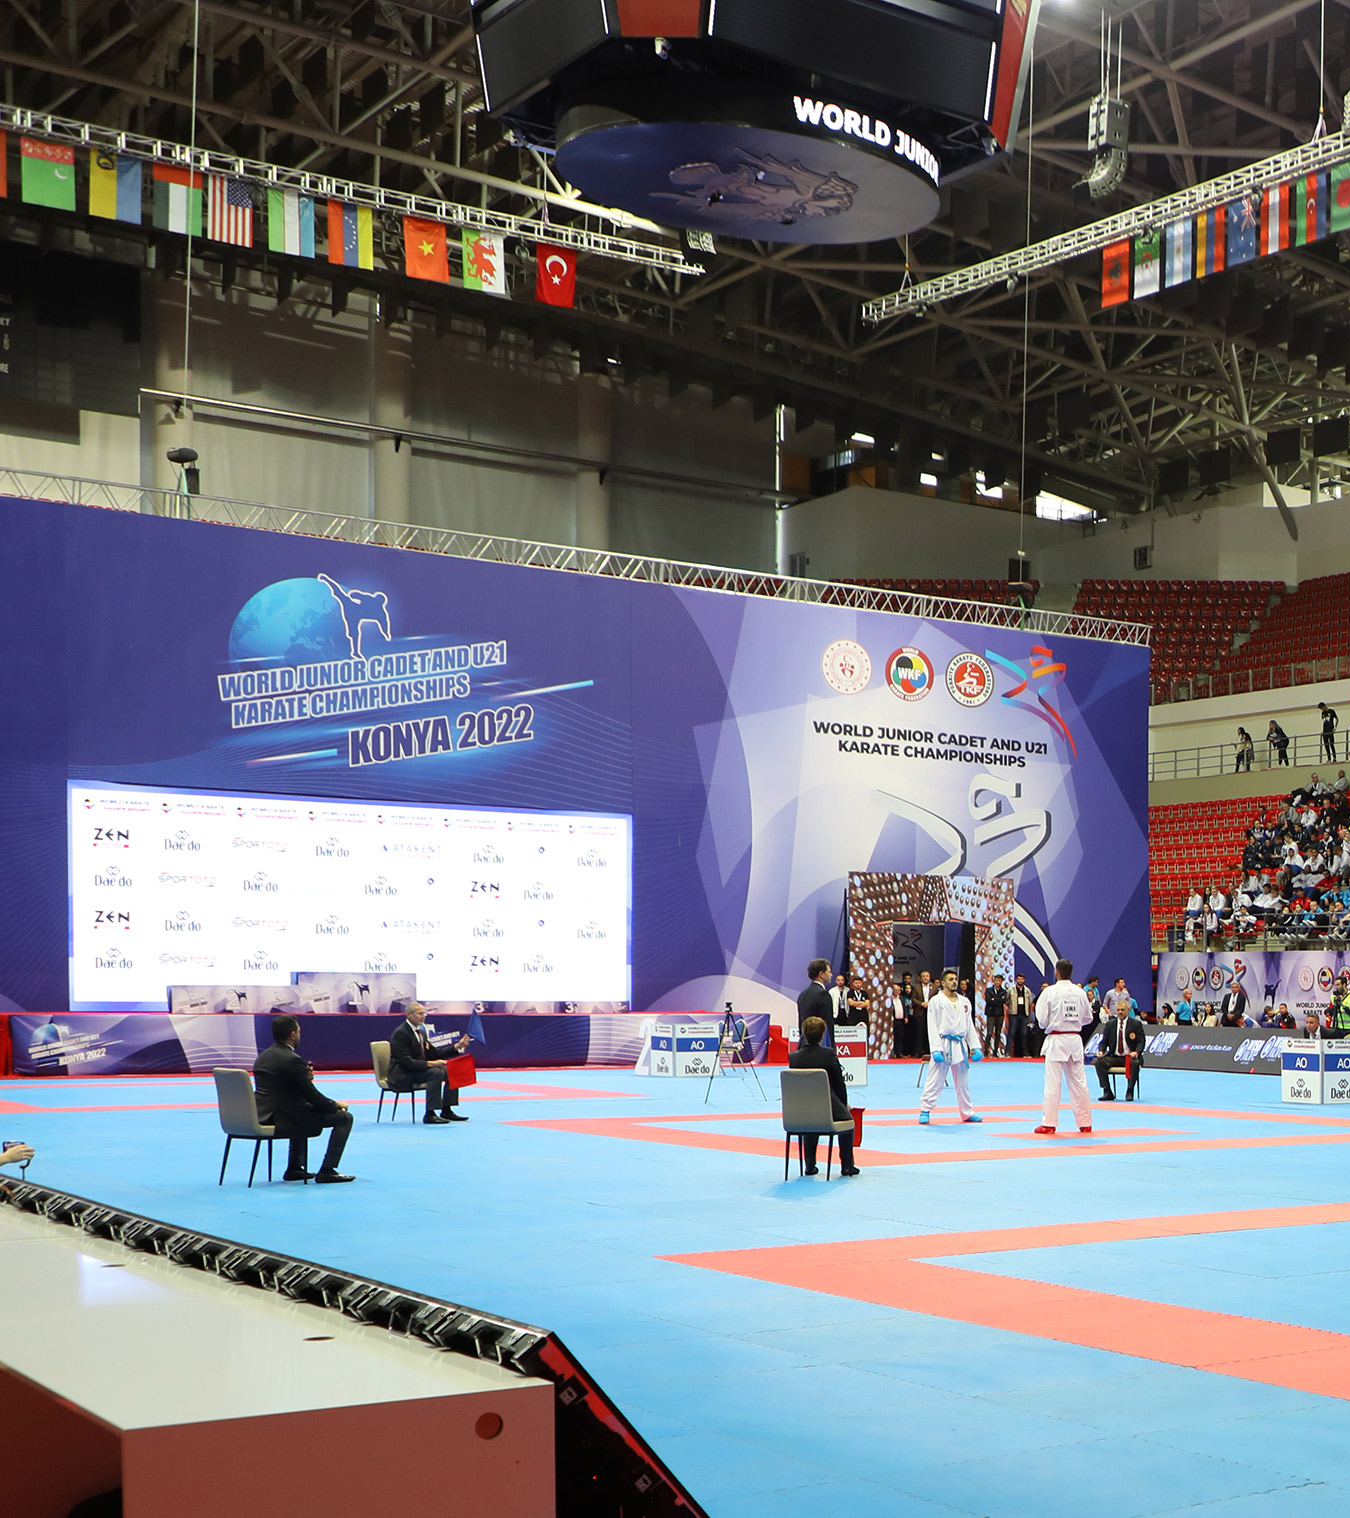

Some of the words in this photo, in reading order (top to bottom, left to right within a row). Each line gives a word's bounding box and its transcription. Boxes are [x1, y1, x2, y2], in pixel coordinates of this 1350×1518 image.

[793, 96, 891, 147] WORLD
[217, 667, 296, 701] WORLD
[297, 658, 367, 690] JUNIOR
[367, 650, 431, 681] CADET
[431, 645, 470, 674] AND
[470, 640, 507, 667] U21
[897, 667, 922, 681] WKF
[231, 694, 310, 729] KARATE
[309, 673, 471, 718] CHAMPIONSHIPS
[348, 715, 454, 768] KONYA
[456, 703, 534, 751] 2022
[812, 720, 874, 738] WORLD
[877, 726, 934, 744] JUNIOR
[937, 732, 987, 748] CADET
[989, 737, 1022, 752] AND
[1024, 740, 1048, 755] U21
[838, 740, 900, 758] KARATE
[903, 745, 1027, 768] CHAMPIONSHIPS
[94, 828, 130, 841] ZEN
[94, 911, 130, 923] ZEN
[690, 1040, 705, 1050] AO
[1295, 1057, 1308, 1068] AO
[1336, 1058, 1350, 1068] AO
